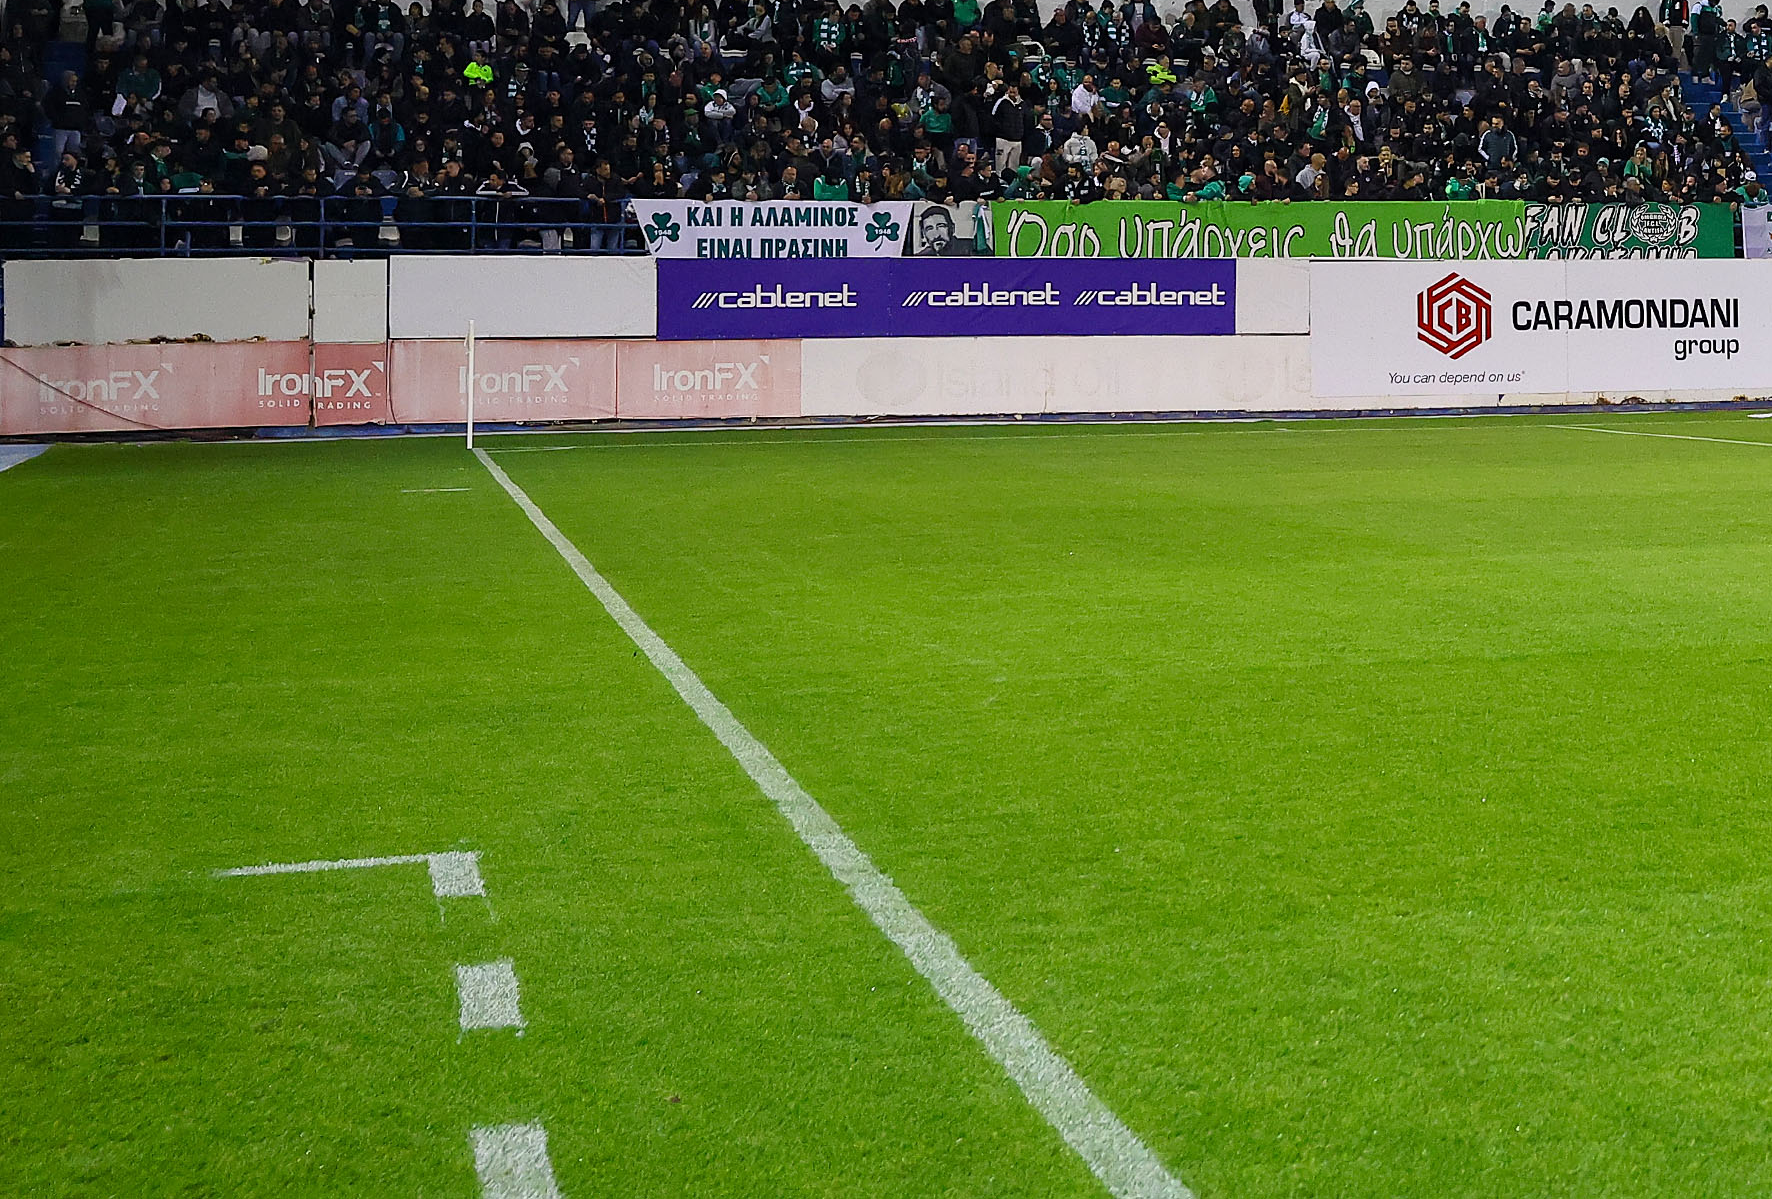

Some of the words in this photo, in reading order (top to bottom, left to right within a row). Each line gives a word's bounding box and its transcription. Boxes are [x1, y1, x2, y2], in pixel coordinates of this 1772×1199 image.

[687, 207, 722, 226] ΚΑΙ
[731, 207, 743, 226] Η
[751, 207, 858, 227] ΑΛΑΜΙΝΟΣ
[1524, 203, 1588, 247] FAN
[1393, 205, 1524, 260] υπάρχω
[697, 238, 752, 258] ΕΙΝΑΙ
[760, 238, 848, 258] ΠΡΑΣΙΝΗ
[718, 283, 857, 308] cablenet
[926, 282, 1060, 307] cablenet
[1097, 282, 1226, 306] cablenet
[1512, 298, 1739, 331] CARAMONDANI
[1674, 337, 1740, 361] group
[39, 370, 160, 402] IronFX
[258, 368, 373, 398] IronFX
[653, 361, 759, 392] IronFX
[1389, 371, 1410, 385] You
[1413, 372, 1435, 384] can
[1439, 371, 1485, 386] depend
[1489, 373, 1504, 383] on
[259, 399, 301, 408] SOLID
[315, 400, 372, 409] RADING
